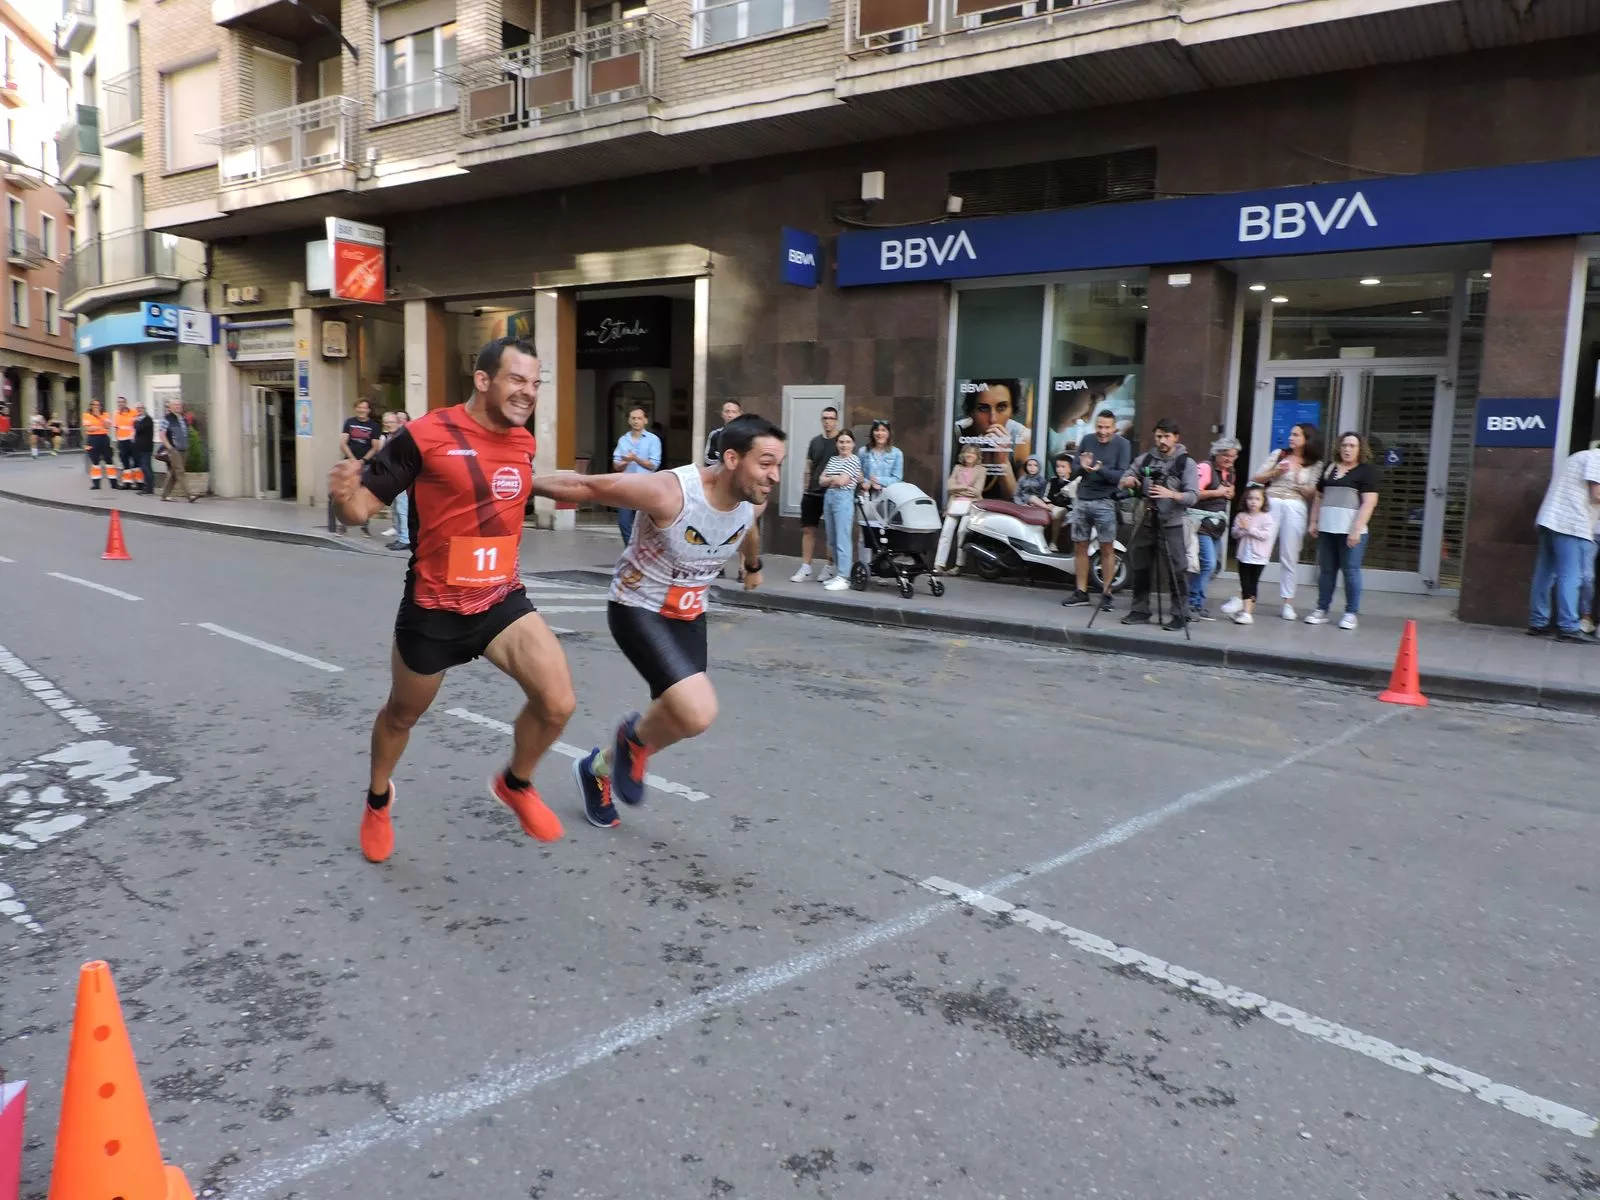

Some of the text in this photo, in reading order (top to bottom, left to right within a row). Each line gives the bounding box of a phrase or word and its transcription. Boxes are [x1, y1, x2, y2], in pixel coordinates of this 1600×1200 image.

[1238, 192, 1378, 242] BBVA
[788, 248, 816, 267] BBVA
[880, 230, 977, 271] BBVA
[960, 382, 990, 394] BBVA
[1055, 379, 1089, 392] BBVA
[1486, 414, 1546, 431] BBVA
[473, 547, 498, 572] 11
